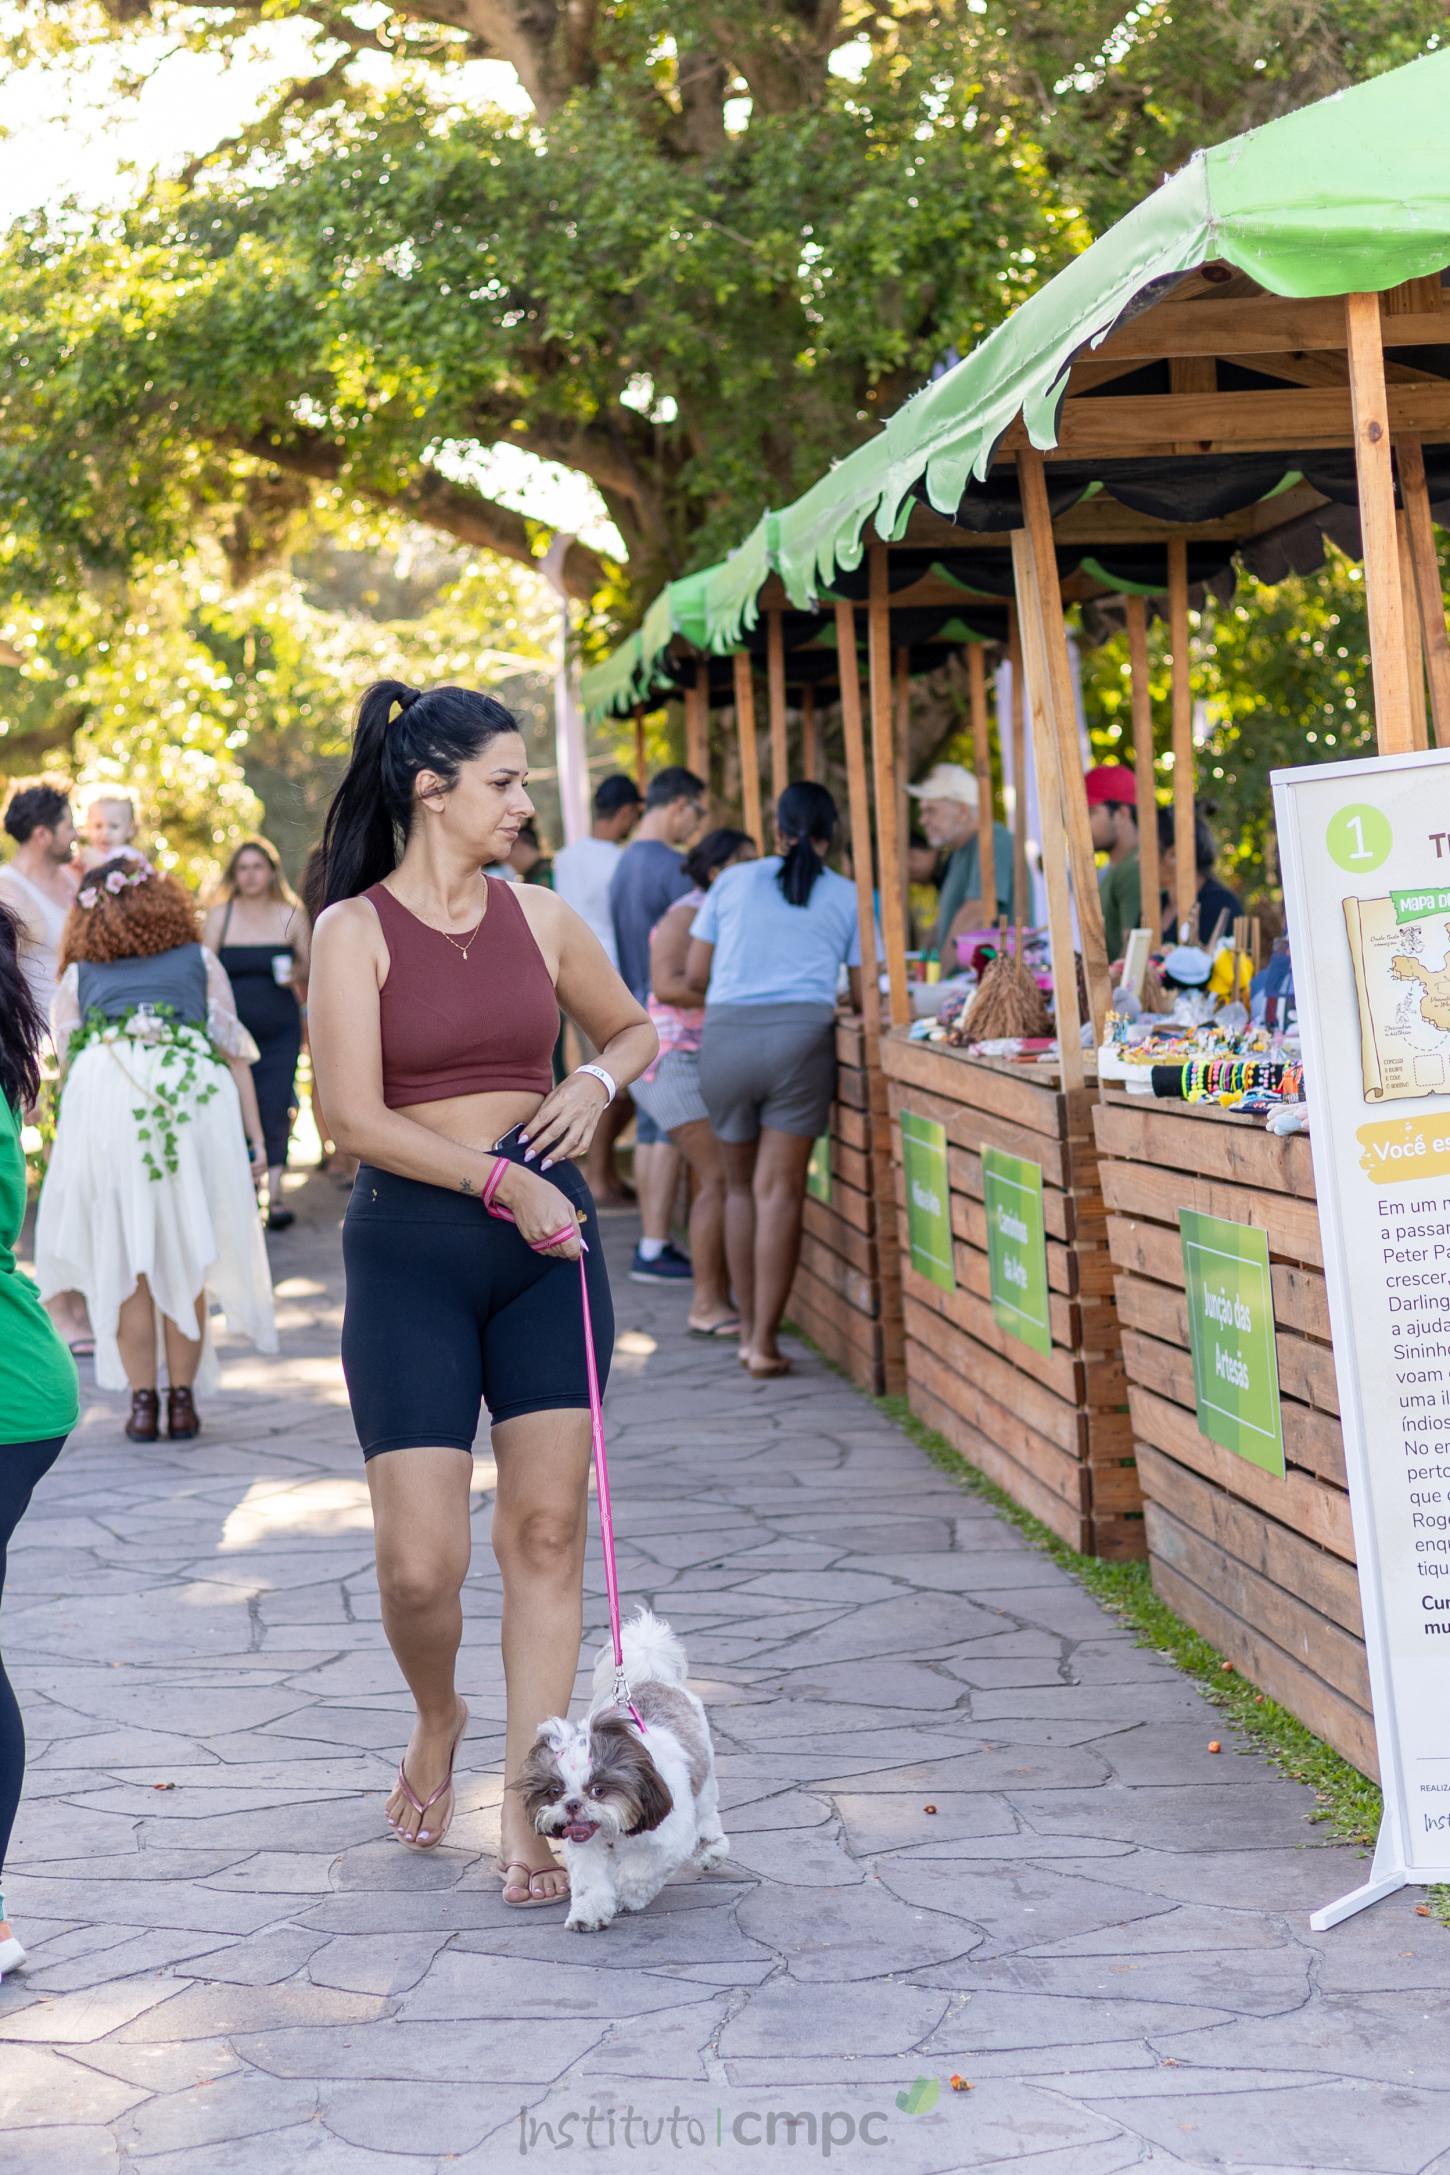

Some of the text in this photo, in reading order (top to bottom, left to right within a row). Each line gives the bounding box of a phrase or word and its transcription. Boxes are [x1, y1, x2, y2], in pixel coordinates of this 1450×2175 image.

[1346, 815, 1374, 859] 1
[1372, 1134, 1426, 1161] Você
[1378, 1200, 1405, 1216] Em
[1411, 1200, 1437, 1213] um
[1381, 1228, 1390, 1240] a
[1383, 1248, 1429, 1264] Peter
[1203, 1281, 1252, 1333] Junção das
[1388, 1294, 1450, 1312] Darling
[1391, 1317, 1450, 1338] a ajuda
[1393, 1341, 1450, 1360] Sininh
[1215, 1341, 1249, 1391] Artesãs
[1395, 1370, 1443, 1384] voam
[1400, 1394, 1436, 1408] uma
[1402, 1415, 1450, 1432] índios
[1404, 1440, 1429, 1456] No
[1410, 1491, 1442, 1507] que
[1412, 1512, 1450, 1530] Rog
[1415, 1539, 1450, 1555] enq
[1417, 1560, 1449, 1579] tiqu
[1420, 1784, 1450, 1792] REALIZ
